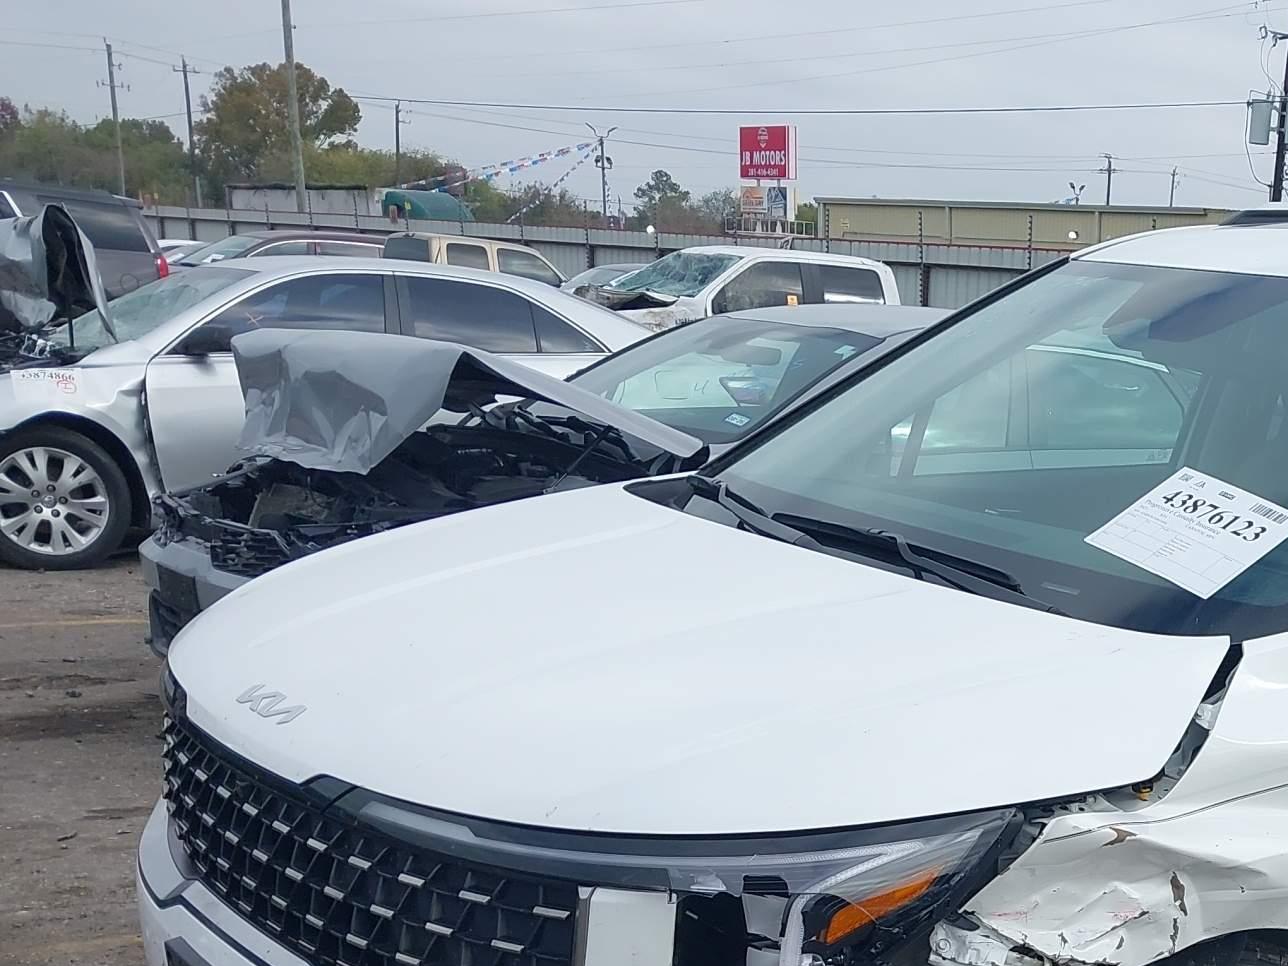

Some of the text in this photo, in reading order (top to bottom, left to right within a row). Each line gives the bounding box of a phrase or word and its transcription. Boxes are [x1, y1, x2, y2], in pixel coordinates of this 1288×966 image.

[742, 150, 785, 166] JB MOTORS
[1162, 490, 1267, 542] 43876123
[235, 683, 307, 726] KIA
